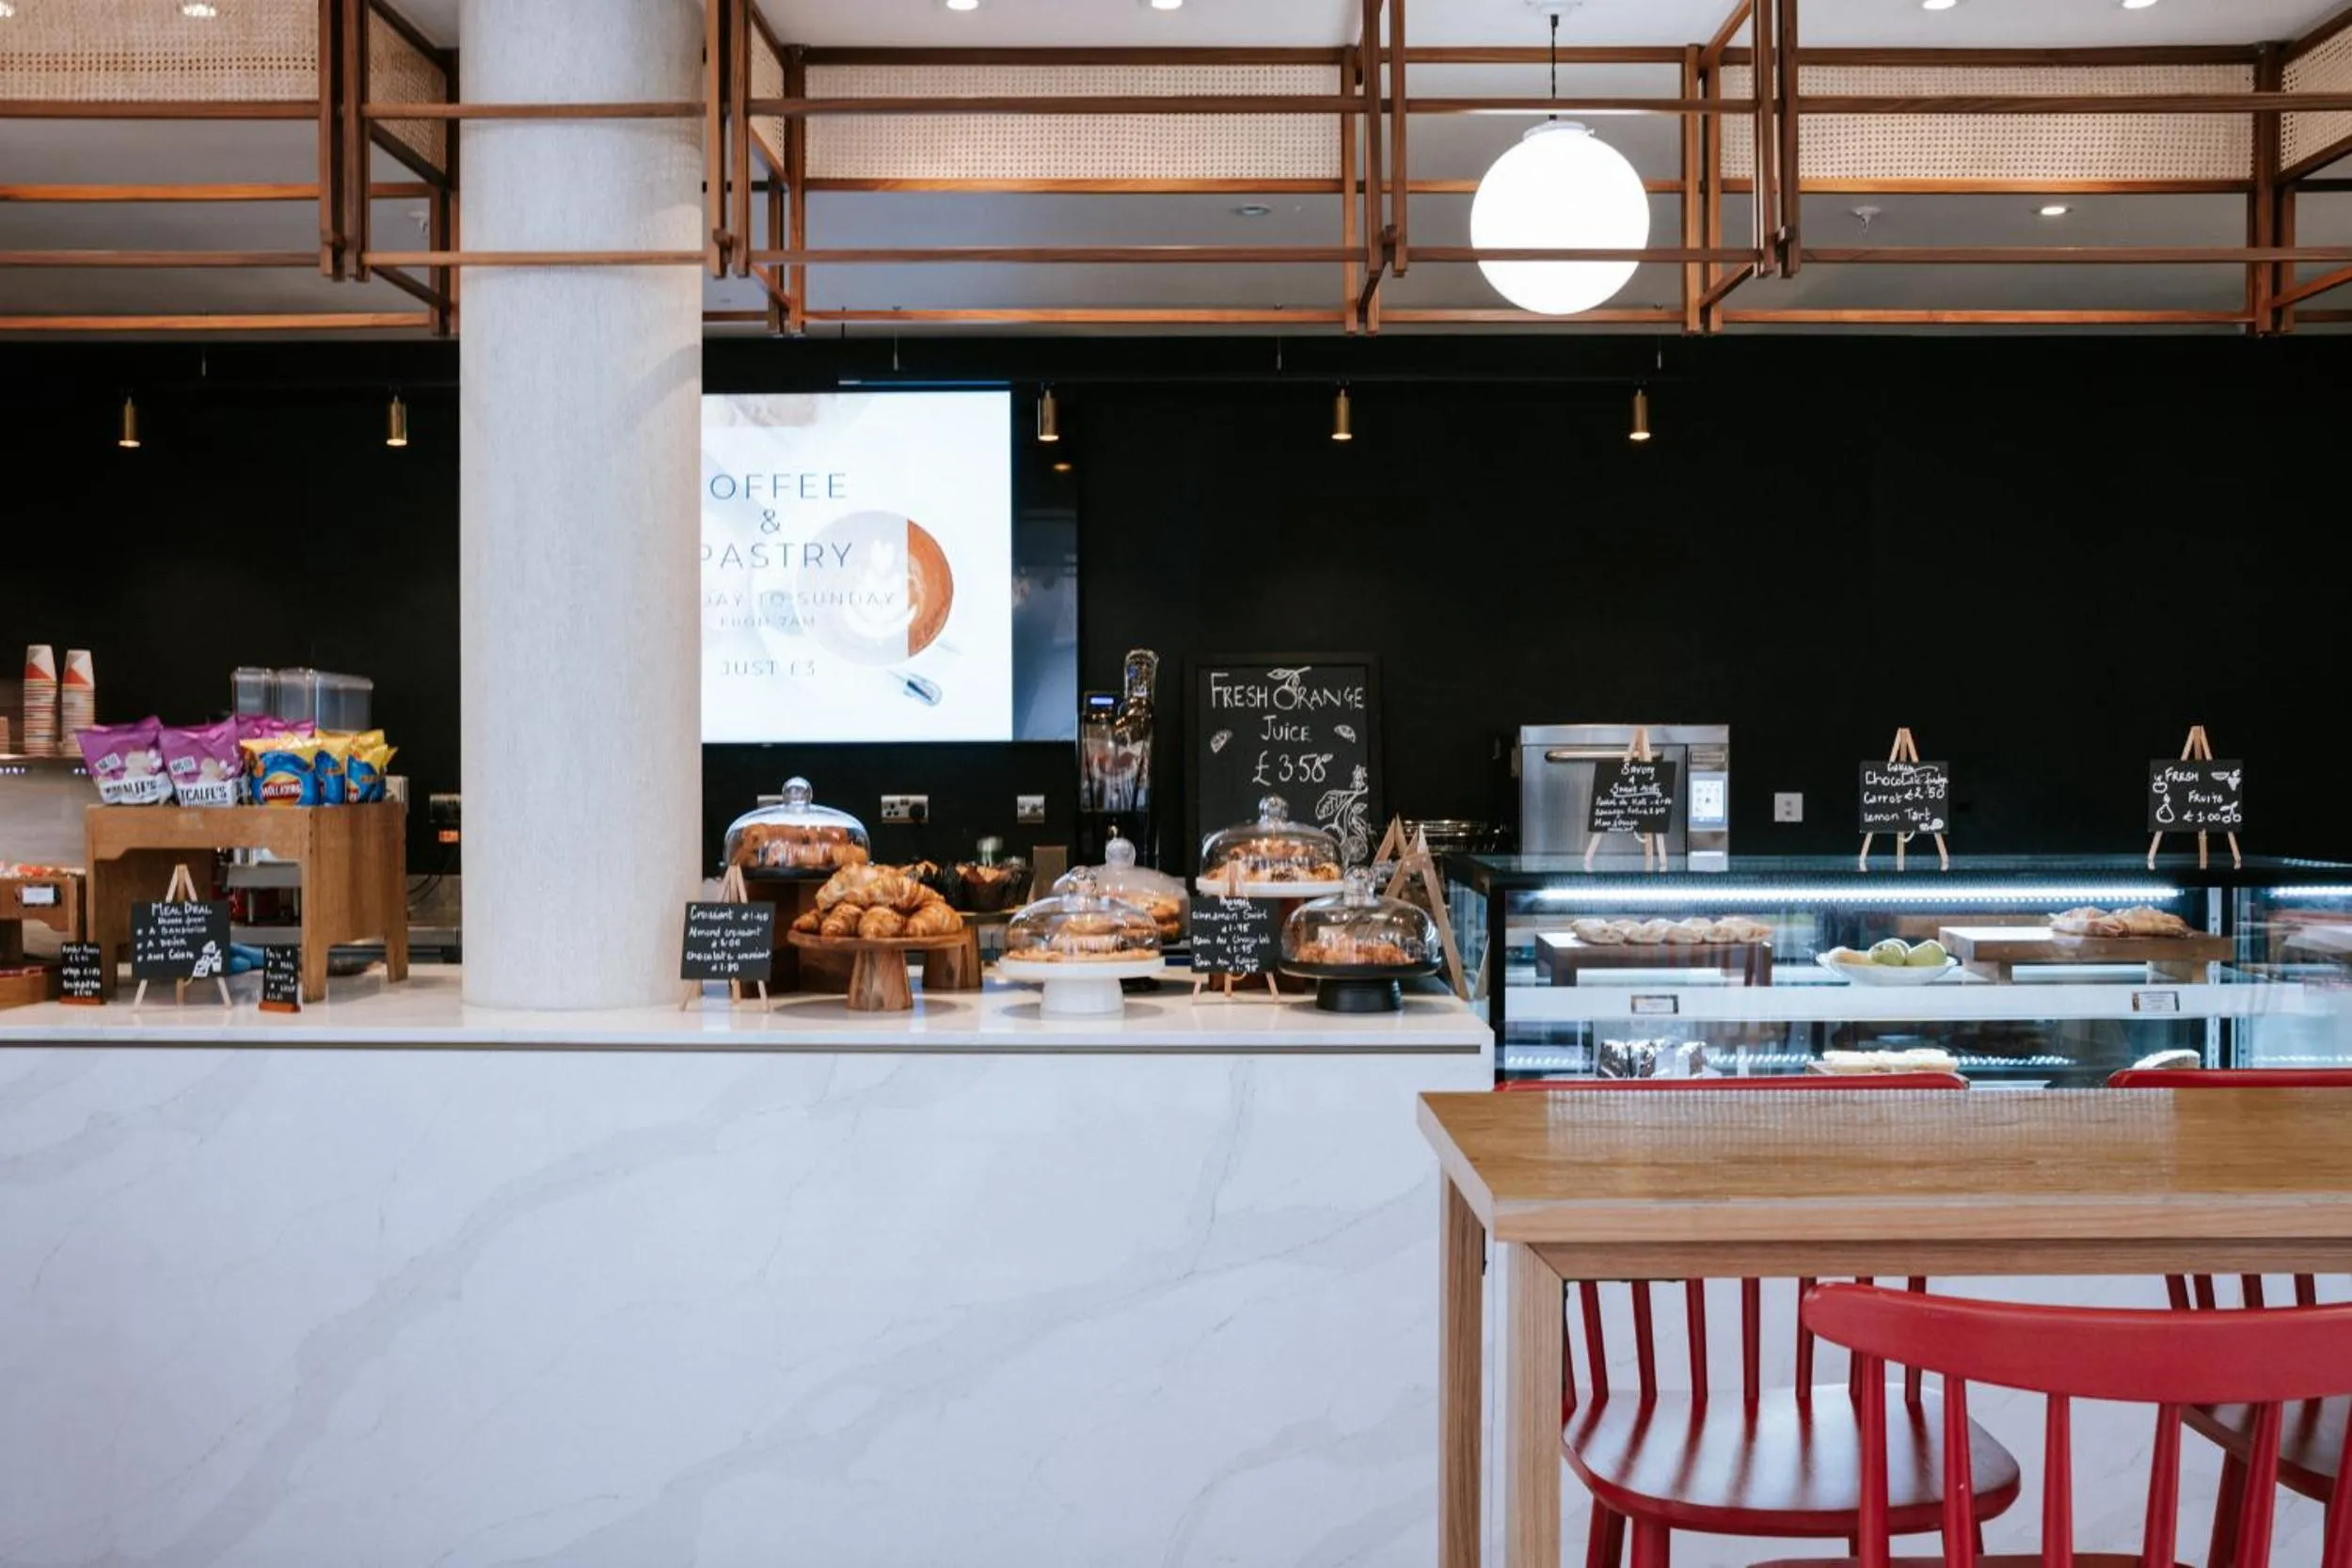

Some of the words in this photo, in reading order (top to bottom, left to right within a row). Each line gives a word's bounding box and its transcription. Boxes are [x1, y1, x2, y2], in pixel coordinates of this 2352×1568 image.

[760, 508, 781, 535] &
[799, 592, 895, 607] SUNDAY
[722, 660, 774, 675] JUST
[1210, 672, 1268, 708] FRESH
